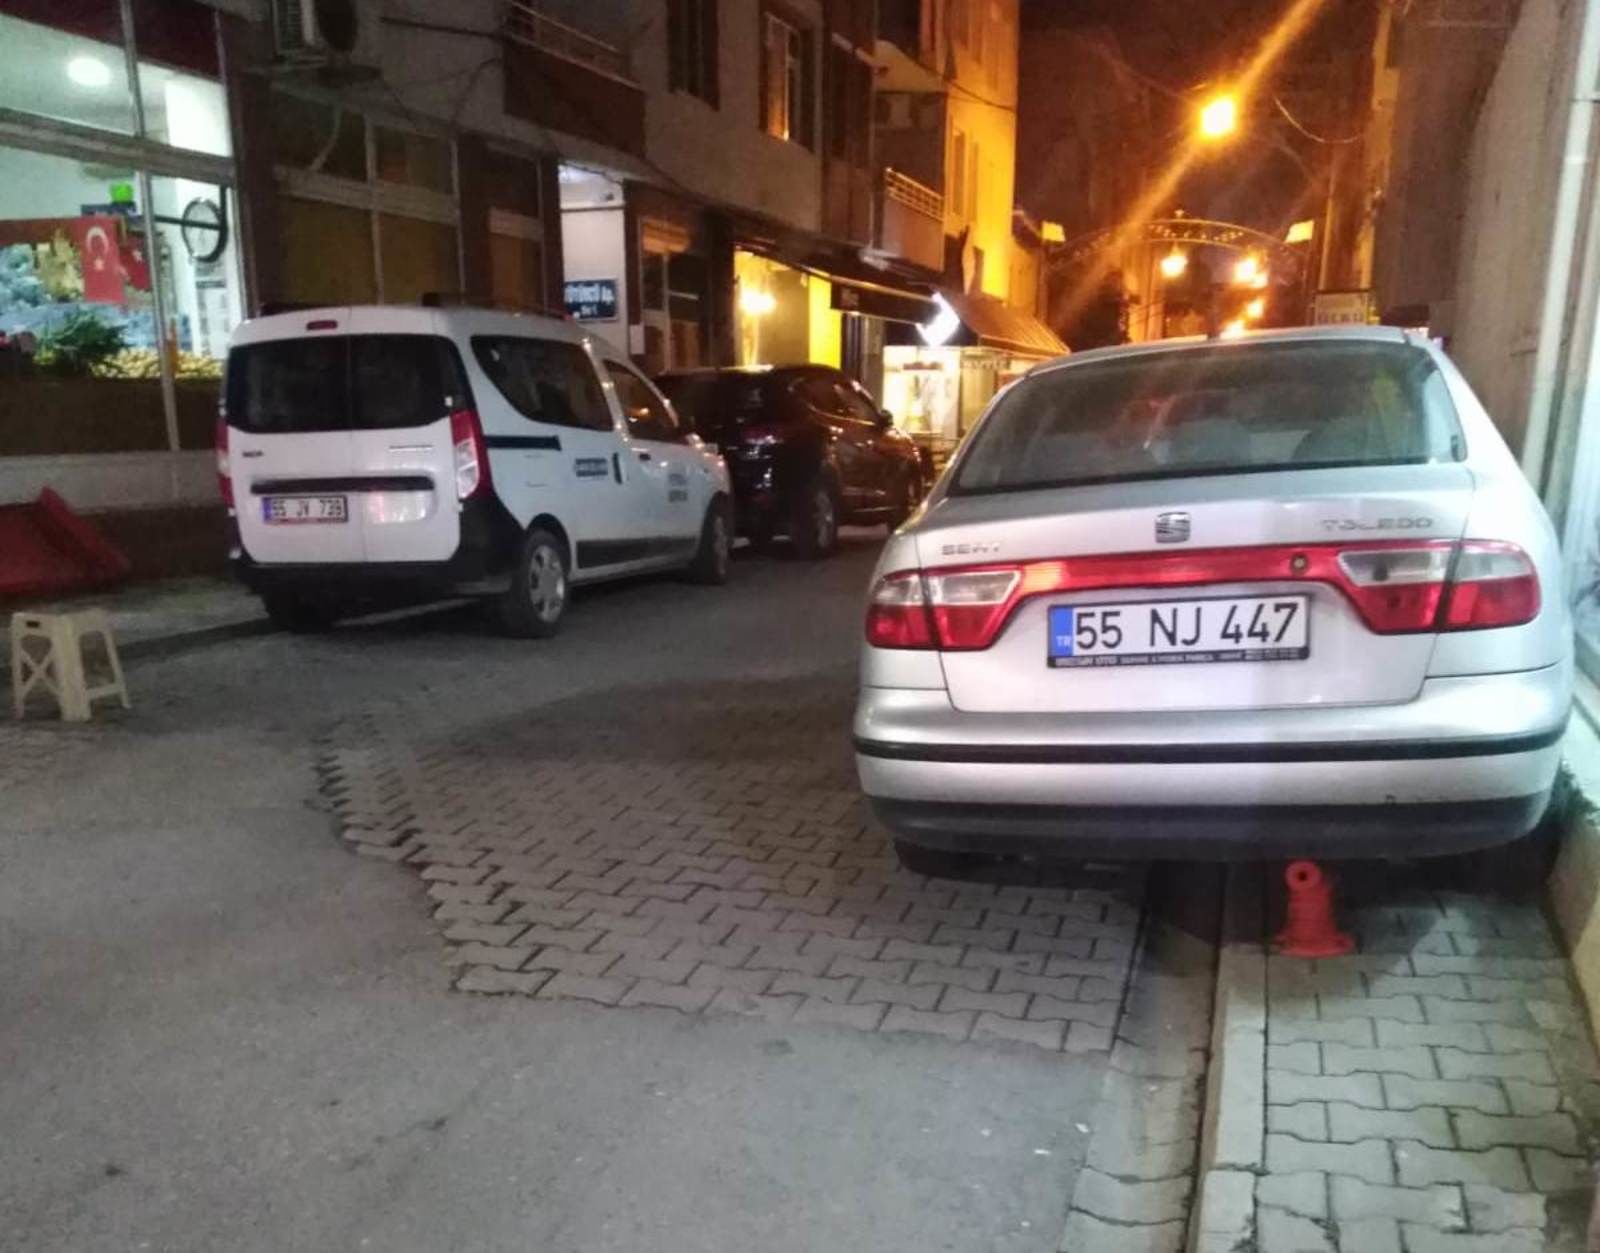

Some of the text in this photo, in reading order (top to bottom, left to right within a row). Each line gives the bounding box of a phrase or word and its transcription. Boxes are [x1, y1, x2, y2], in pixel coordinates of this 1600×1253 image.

[1320, 516, 1434, 532] TOLEDO
[941, 542, 1001, 556] SEAT
[1075, 610, 1122, 650] 55
[1150, 606, 1202, 647] NJ
[1219, 602, 1299, 644] 447
